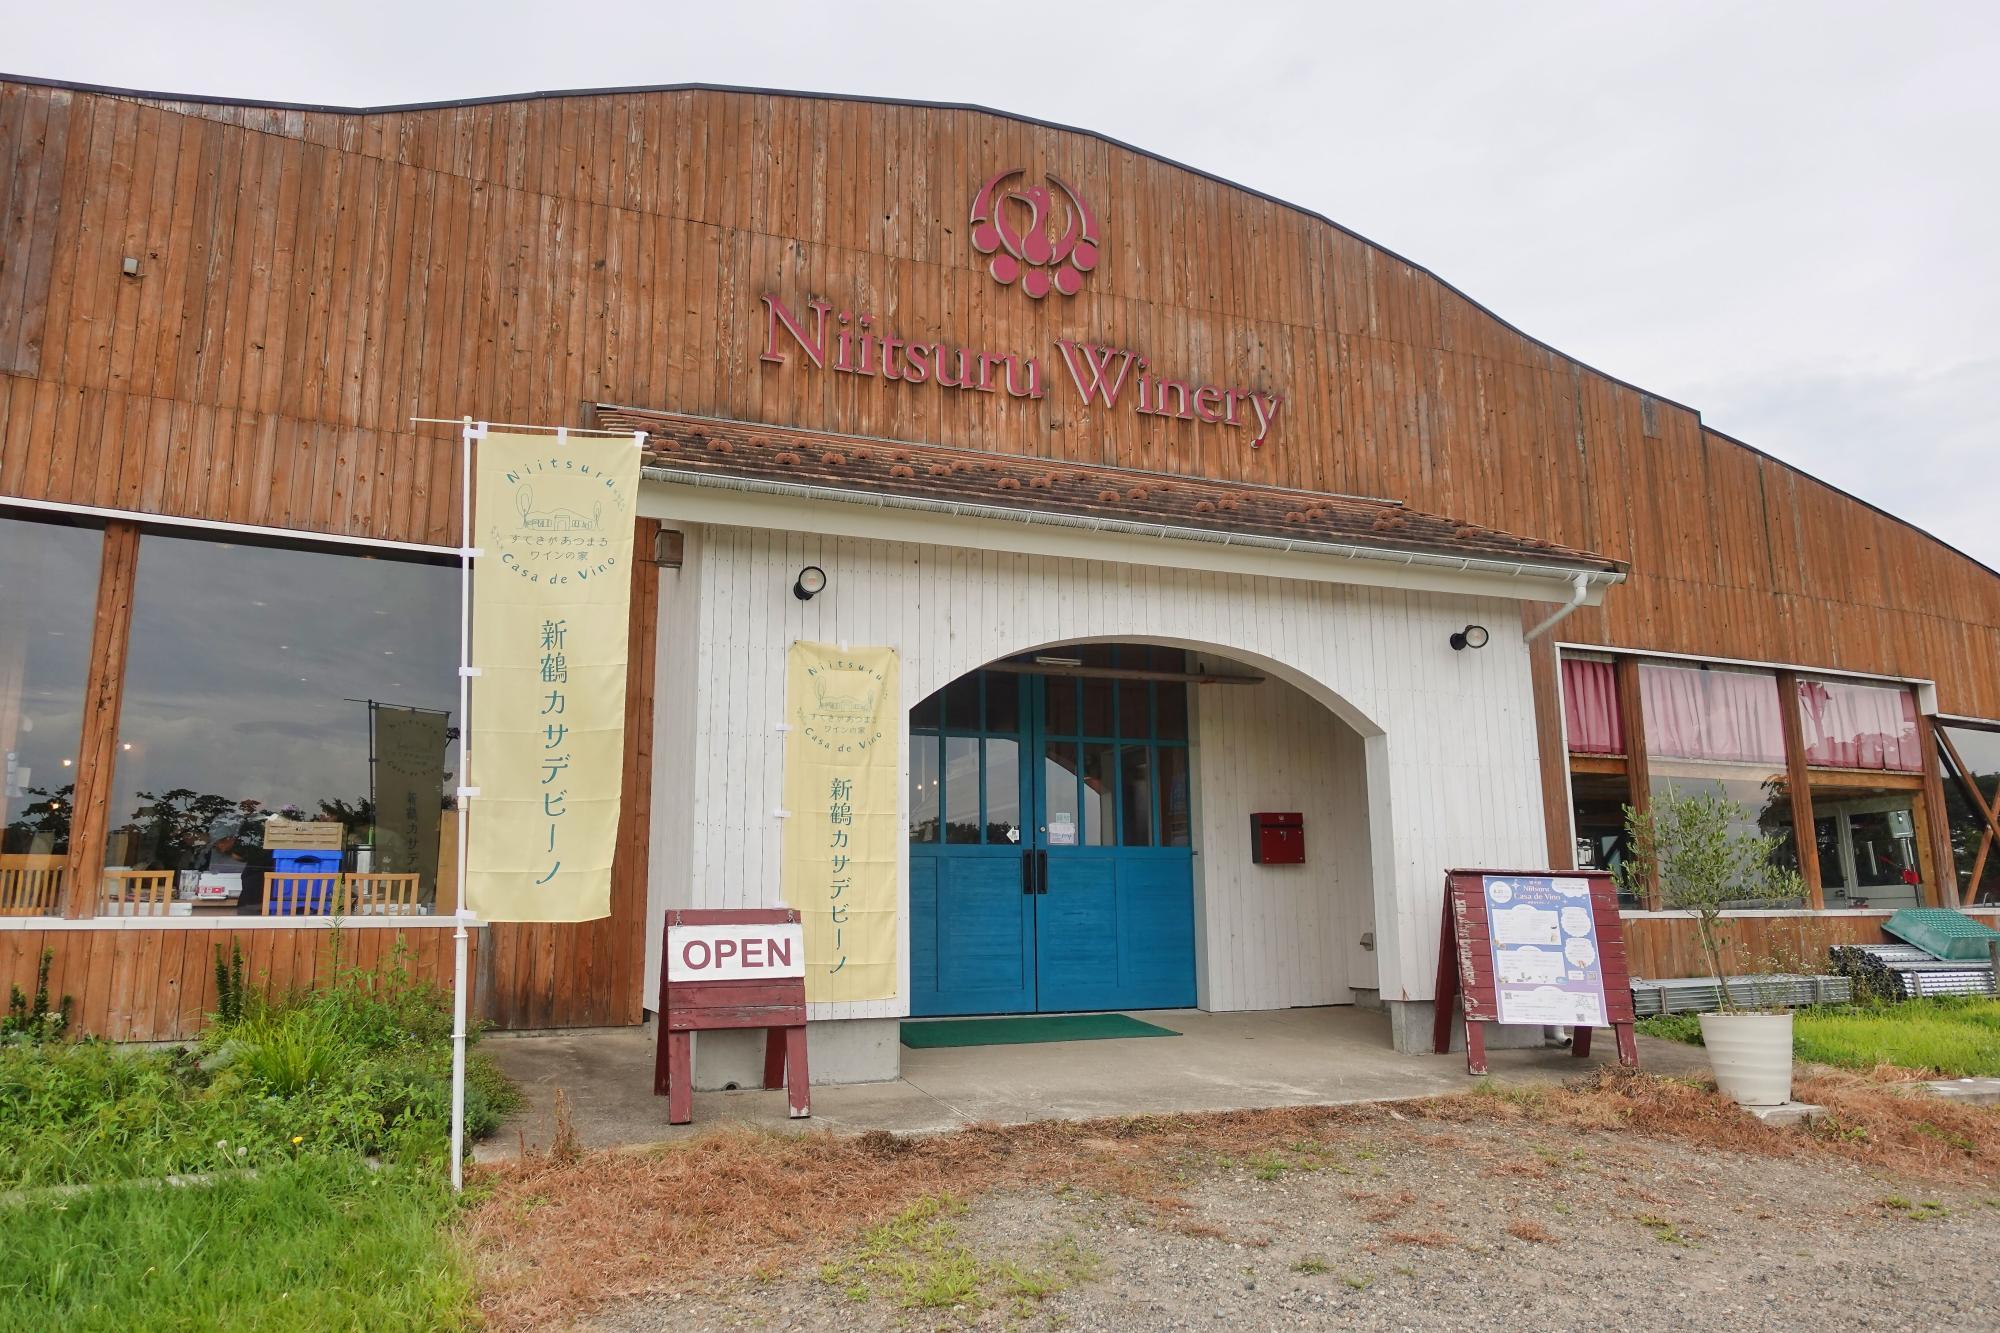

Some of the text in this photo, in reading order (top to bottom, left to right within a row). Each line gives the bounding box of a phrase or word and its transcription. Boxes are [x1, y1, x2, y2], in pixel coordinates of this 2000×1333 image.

[760, 294, 1283, 449] Niitsuru Winery
[506, 458, 615, 488] Niitsuru
[502, 553, 615, 584] Casa de Vino
[530, 551, 588, 561] ワインの家
[808, 660, 882, 680] Niitsuru
[536, 619, 571, 885] 新鶴カサデビーノ
[805, 728, 882, 752] Casa de Vino
[829, 778, 853, 974] 新鶴カサデビーノ
[682, 938, 791, 970] OPEN
